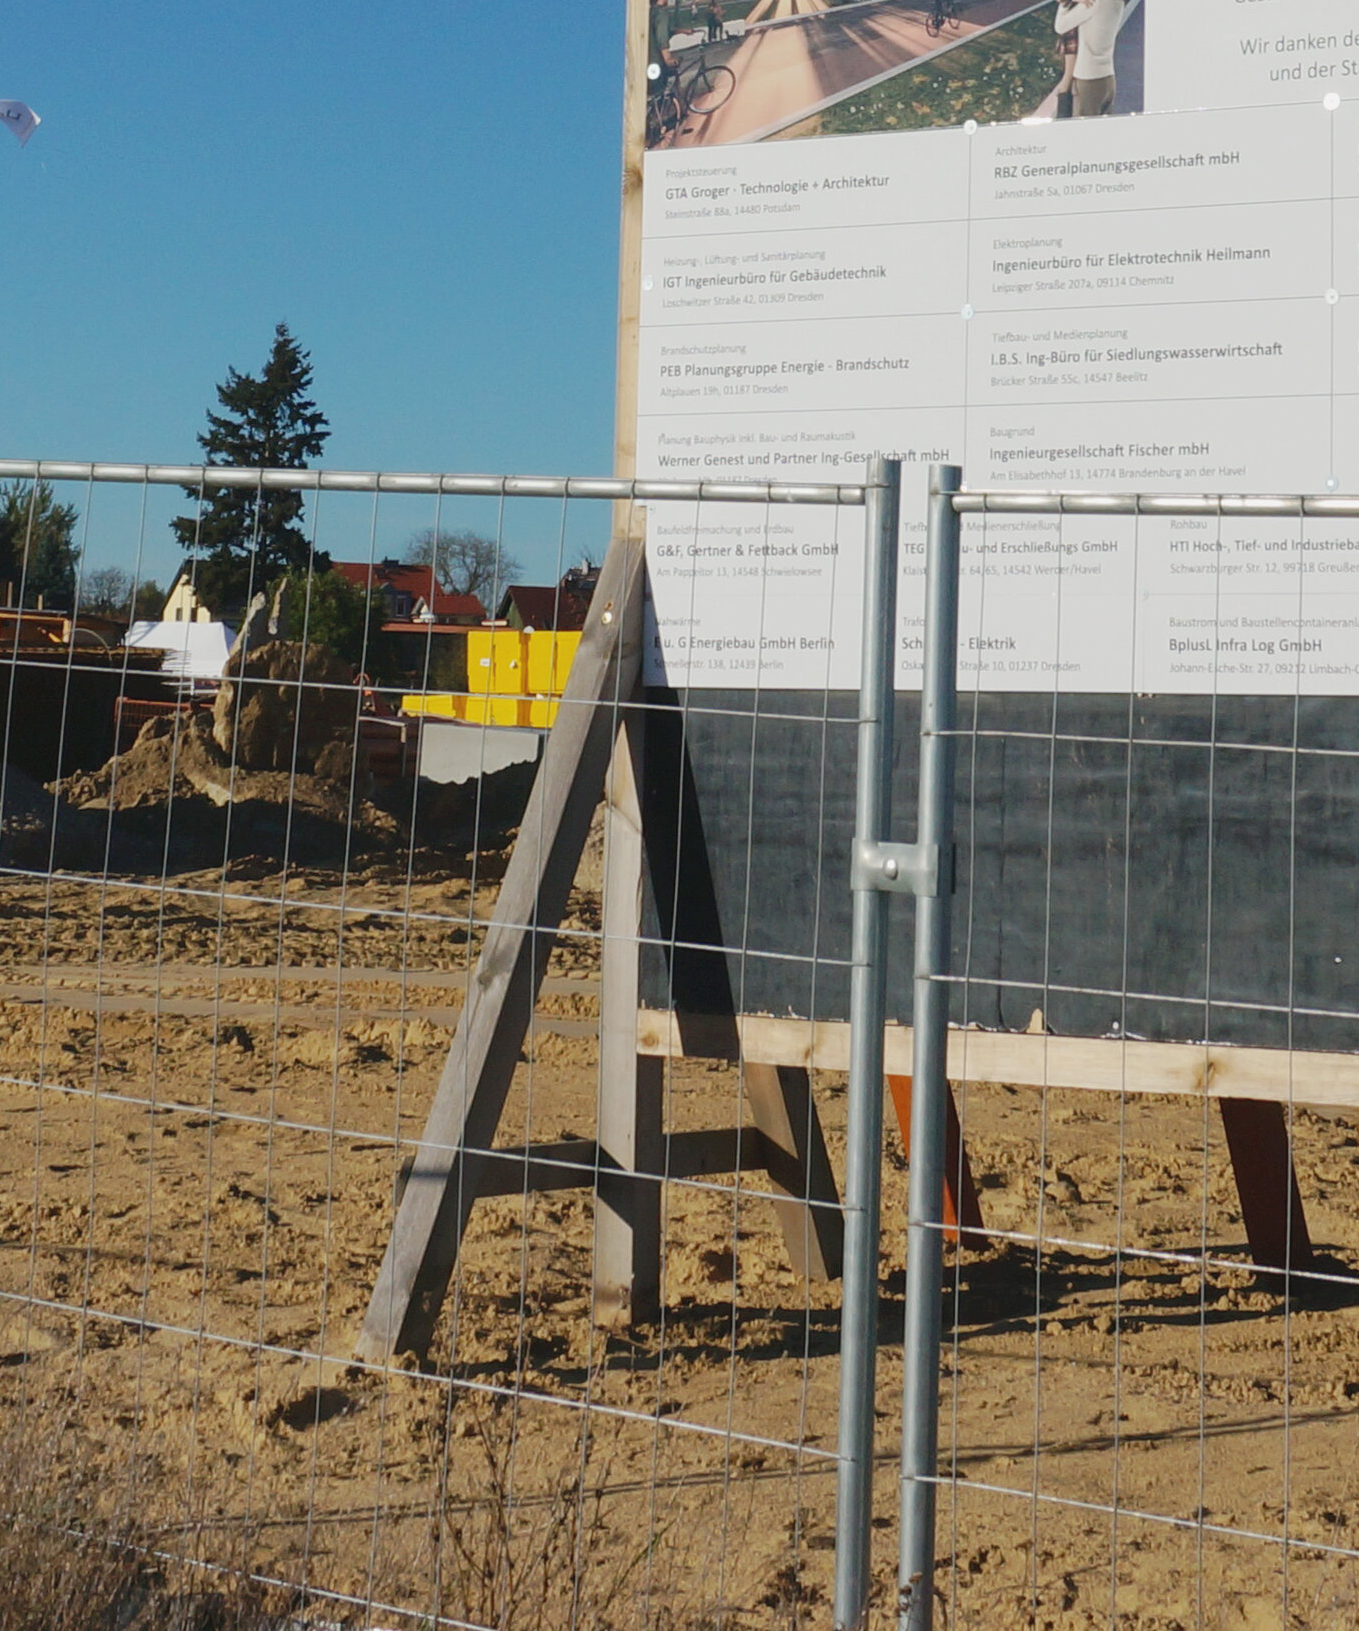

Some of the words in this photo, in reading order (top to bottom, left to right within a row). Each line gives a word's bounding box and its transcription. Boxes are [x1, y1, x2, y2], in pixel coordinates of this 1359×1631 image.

[1240, 38, 1270, 55] Wir
[1275, 33, 1337, 52] danken
[1270, 63, 1301, 81] und
[1307, 61, 1336, 78] der
[994, 166, 1018, 178] RBZ
[1021, 153, 1204, 177] Generalplanungsgesellschaft
[1209, 151, 1239, 165] mbH
[665, 187, 688, 200] GTA
[740, 179, 808, 195] Technologie
[822, 175, 889, 190] Architektur
[993, 256, 1082, 274] Ingenieurbüro
[1086, 254, 1104, 267] für
[1108, 249, 1202, 266] Elektrotechnik
[1206, 247, 1270, 261] Heilmann
[663, 276, 682, 288] IGT
[685, 272, 766, 289] Ingenieurbüro
[769, 271, 786, 283] für
[790, 265, 886, 282] Gebäudetechnik
[991, 353, 1021, 365] I.B.S.
[1026, 350, 1080, 367] Ing-Büro
[1084, 349, 1103, 362] für
[1107, 342, 1283, 363] Siedlungswasserwirtschaft
[660, 365, 681, 377] PEB
[685, 364, 777, 378] Planungsgruppe
[781, 360, 824, 375] Energie
[836, 357, 909, 371] Brandschutz
[658, 455, 700, 467] Werner
[704, 454, 744, 466] Genest
[748, 452, 770, 465] und
[774, 453, 817, 464] Partner
[921, 449, 950, 461] mbH
[990, 444, 1124, 463] Ingenieurgesellschaft
[1129, 443, 1174, 457] Fischer
[1178, 442, 1209, 455] mbH
[1170, 520, 1208, 530] Rohbau
[657, 545, 683, 559] G&F,
[687, 544, 733, 558] Gertner
[735, 544, 744, 556] &
[802, 543, 839, 557] GmbH
[904, 543, 925, 554] TEG
[976, 542, 997, 553] und
[1001, 542, 1078, 555] Erschließungs
[1082, 541, 1118, 552] GmbH
[1234, 540, 1261, 552] Tief-
[1264, 540, 1288, 551] und
[664, 639, 674, 649] u.
[678, 637, 687, 649] G
[690, 636, 755, 650] Energiebau
[759, 636, 797, 650] GmbH
[800, 636, 835, 650] Berlin
[969, 637, 1016, 650] Elektrik
[1216, 639, 1247, 652] Infra
[1251, 639, 1275, 655] Log
[1279, 639, 1322, 652] GmbH
